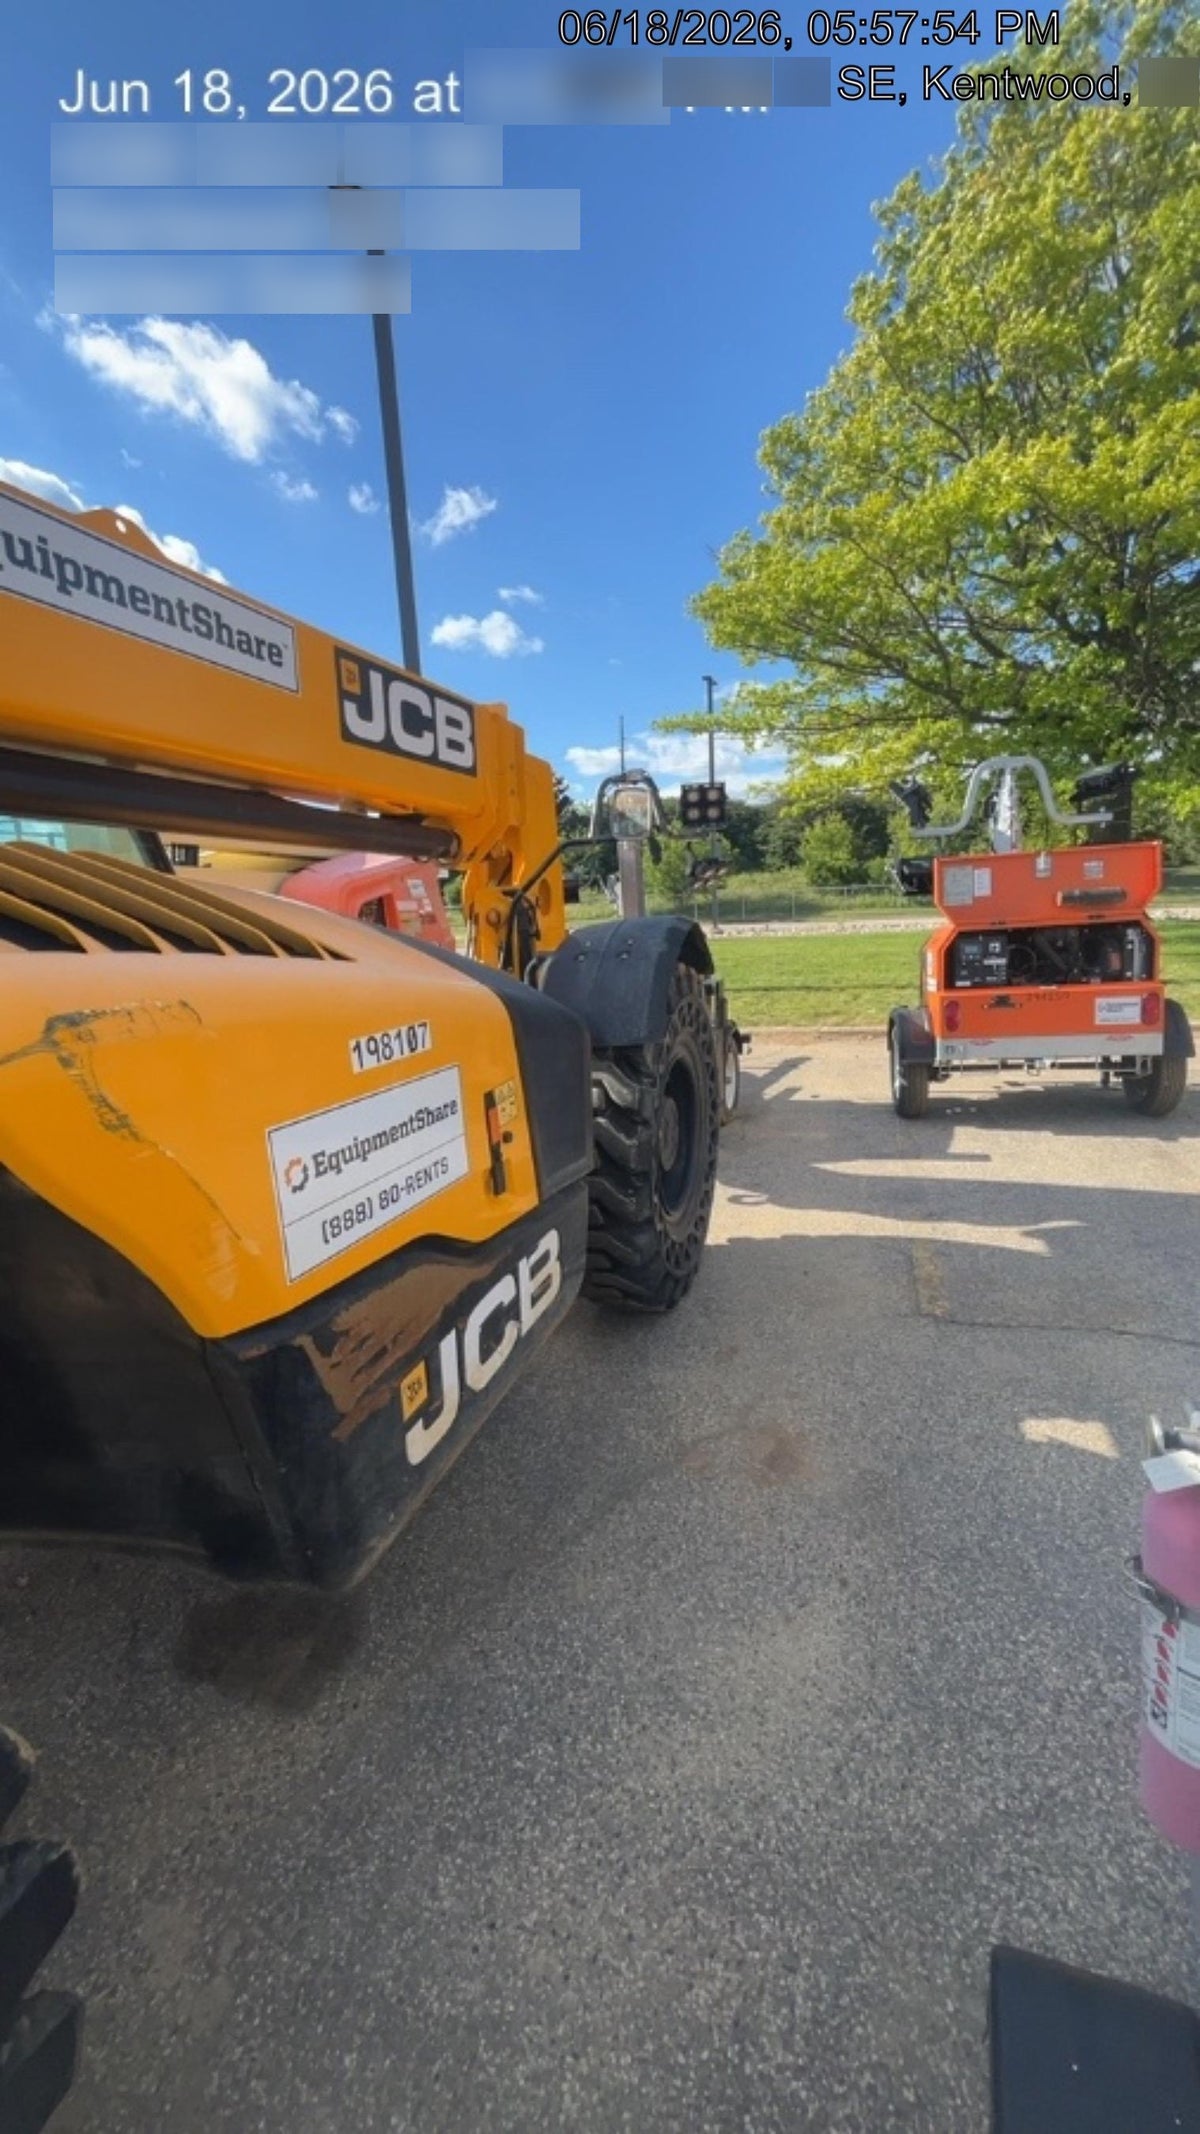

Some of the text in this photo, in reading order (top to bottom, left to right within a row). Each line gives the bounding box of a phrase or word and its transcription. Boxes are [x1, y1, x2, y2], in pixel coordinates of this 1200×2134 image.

[0, 530, 284, 668] uipmentShare
[343, 669, 474, 769] JCB
[353, 1022, 428, 1069] 198107
[312, 1099, 459, 1179] EquipmentShare
[321, 1156, 450, 1245] (888) 80-RENTS
[405, 1229, 560, 1467] JCB
